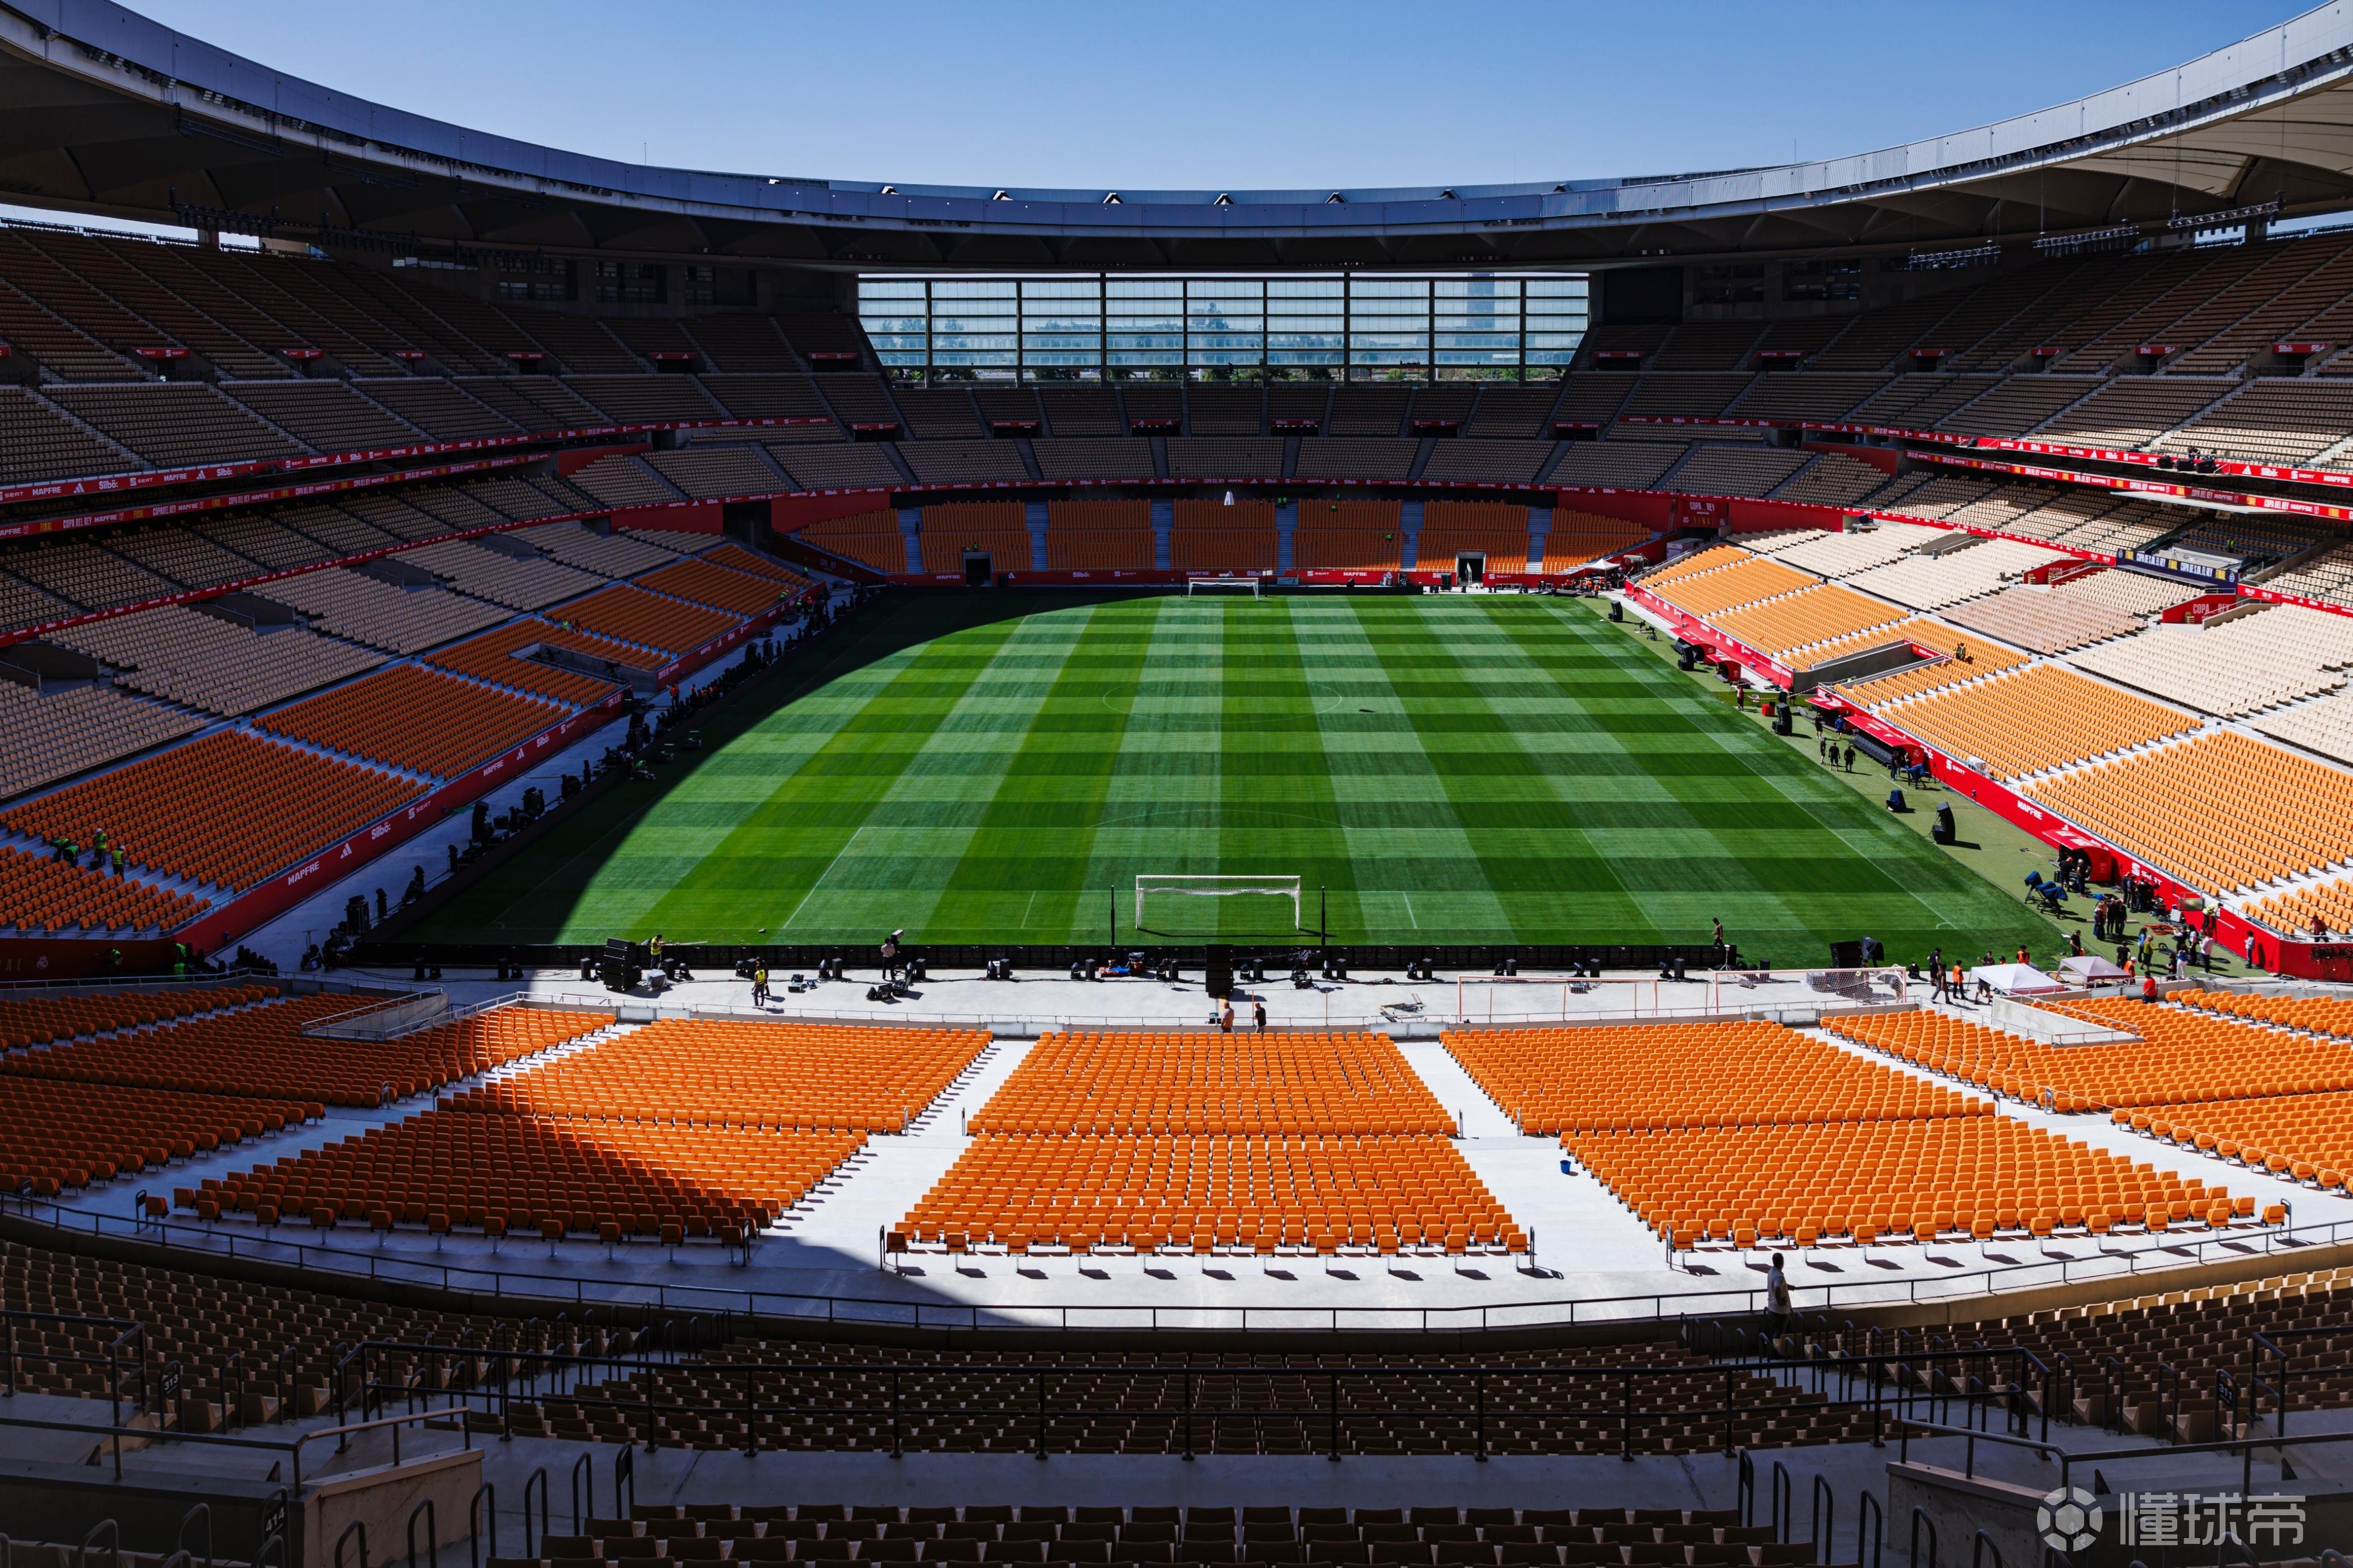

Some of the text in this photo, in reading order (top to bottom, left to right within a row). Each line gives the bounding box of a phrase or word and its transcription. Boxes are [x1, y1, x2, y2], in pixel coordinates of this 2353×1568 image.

[350, 453, 362, 461] Silbö:
[217, 468, 233, 476] Silbö:
[164, 473, 187, 482] MAPFRE
[2323, 474, 2351, 484] MAPFRE
[99, 480, 118, 490] Silbö:
[32, 486, 61, 496] MAPFRE
[252, 492, 269, 500] MAPFRE
[2214, 493, 2234, 501] MAPFRE
[153, 507, 163, 516] COPA
[178, 503, 198, 511] MAPFRE
[1689, 501, 1702, 511] COPA
[1706, 503, 1715, 512] REY
[63, 519, 75, 528] COPA
[94, 514, 118, 523] MAPFRE
[0, 527, 21, 536] APFRE
[2136, 552, 2144, 562] COPA
[2181, 562, 2189, 572] COPA
[2189, 563, 2193, 573] DE
[2193, 604, 2229, 614] COPA REY
[483, 759, 504, 777] MAPFRE
[416, 800, 431, 813] SEAT
[2018, 800, 2043, 820] MAPFRE
[371, 821, 391, 840] Silbö:
[288, 860, 320, 886] MAPFRE
[164, 1374, 178, 1391] 313
[2219, 1384, 2232, 1400] 311
[266, 1507, 285, 1532] 414
